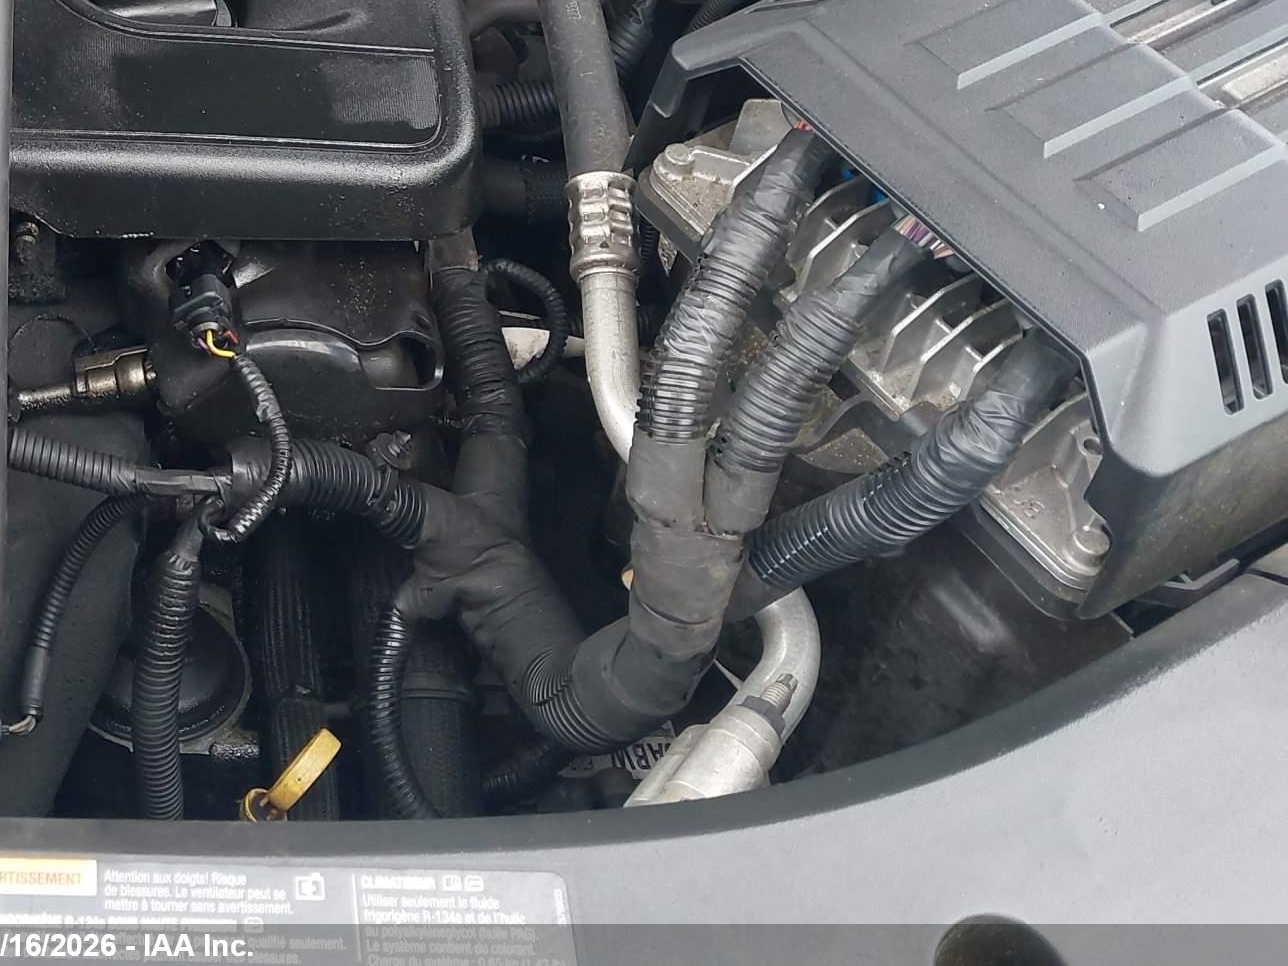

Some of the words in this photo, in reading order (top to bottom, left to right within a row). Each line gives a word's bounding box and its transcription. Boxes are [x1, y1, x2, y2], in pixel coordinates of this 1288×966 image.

[104, 870, 150, 884] Attention
[153, 872, 172, 884] aux
[174, 872, 209, 886] doigts!
[212, 872, 247, 886] Risque
[105, 884, 118, 896] de
[120, 885, 172, 898] blessures.
[175, 886, 188, 898] Le
[190, 886, 244, 899] ventilateur
[247, 888, 271, 901] peut
[274, 890, 286, 900] se
[104, 898, 138, 912] mettre
[150, 900, 188, 912] tourner
[190, 902, 216, 914] sans
[218, 902, 294, 915] avertissement.
[363, 894, 398, 907] Utiliser
[400, 895, 456, 908] seulement
[458, 896, 467, 909] le
[470, 896, 500, 910] fluide
[364, 909, 420, 925] frigorigène
[423, 910, 462, 924] R-134a
[465, 912, 475, 924] et
[478, 911, 490, 924] de
[366, 926, 379, 938] au
[367, 938, 380, 952] Le
[382, 938, 427, 954] système
[474, 941, 488, 954] du
